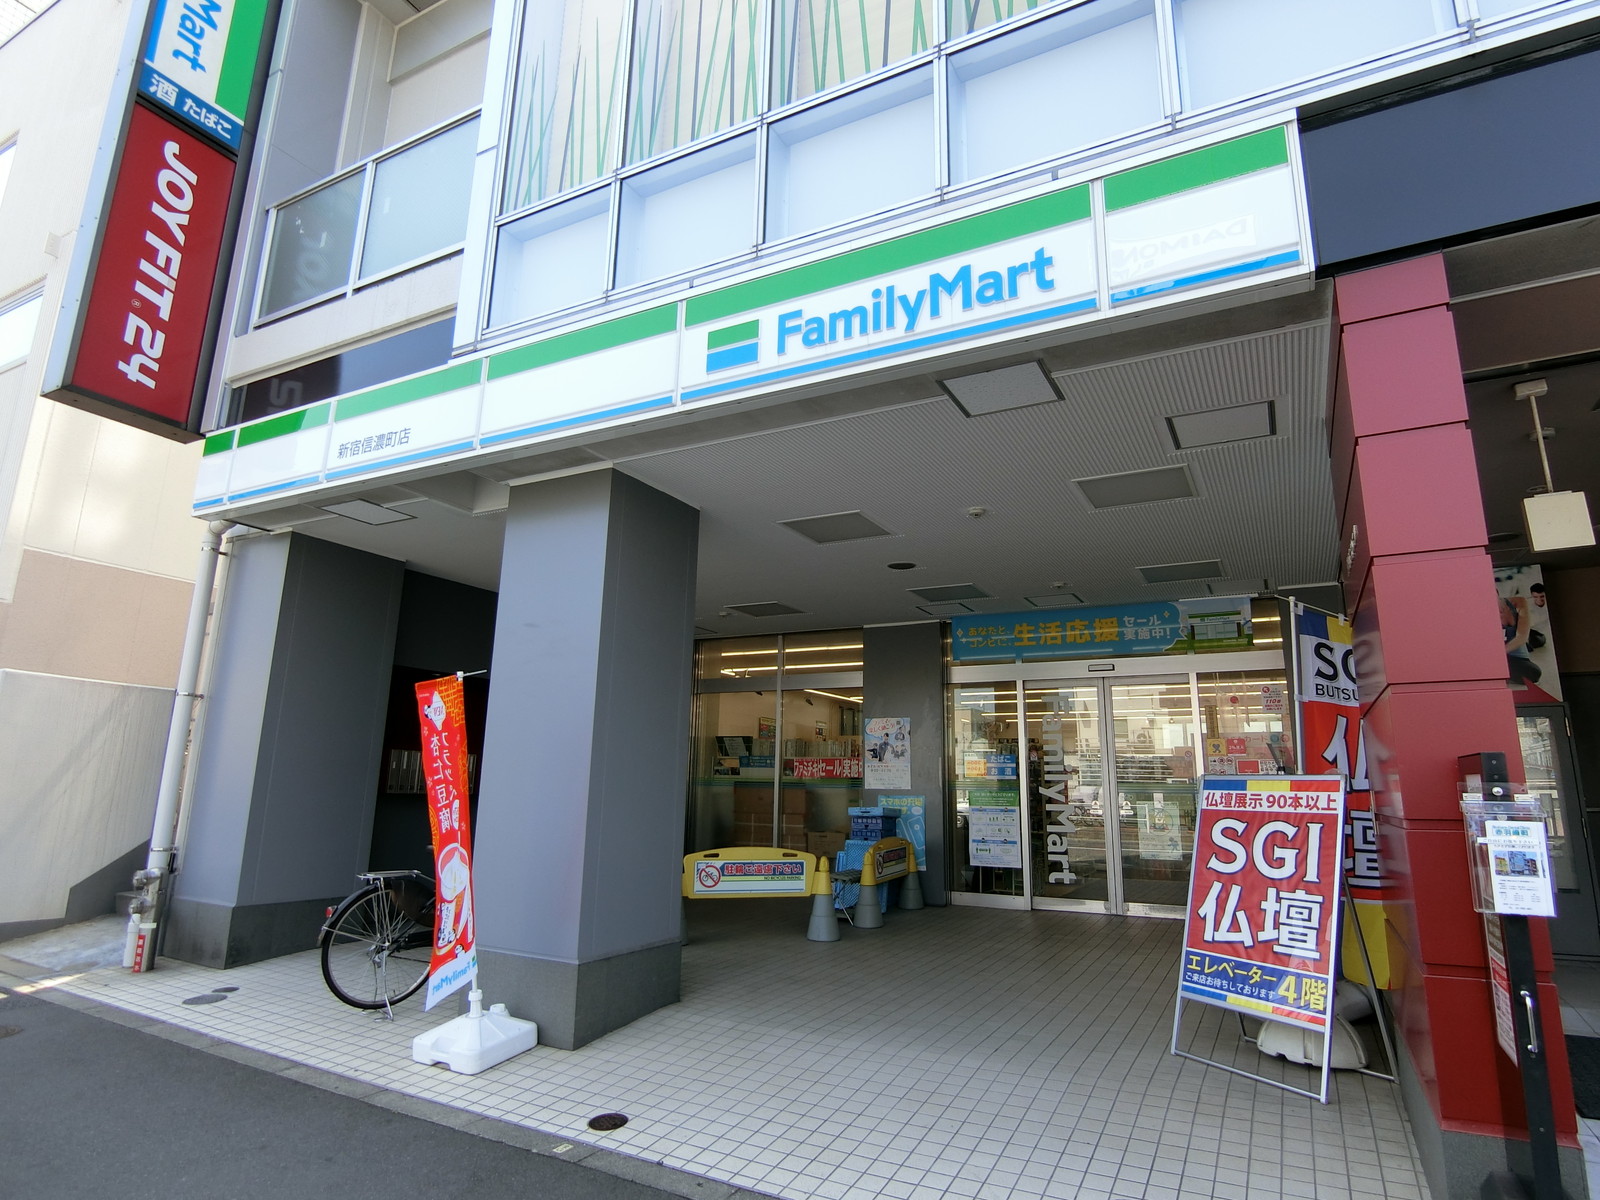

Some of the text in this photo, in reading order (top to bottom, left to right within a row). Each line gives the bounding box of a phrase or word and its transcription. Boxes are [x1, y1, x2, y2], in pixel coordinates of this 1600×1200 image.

[149, 73, 232, 139] 酒 たばこ
[777, 247, 1055, 356] FamilyMart
[337, 428, 411, 459] 新宿信濃町店
[1014, 617, 1120, 647] 生活応援
[1123, 614, 1162, 627] セール
[1039, 695, 1077, 886] FamilyMart
[1204, 792, 1337, 811] 仏壇展示 90本以上
[1206, 818, 1322, 883] SGI
[724, 863, 802, 875] 駐輪ご遠慮下さい
[1197, 880, 1324, 960] 仏壇
[1187, 955, 1277, 984] エレベーター
[1185, 971, 1276, 1000] ご来店お待ちしております
[1277, 977, 1327, 1011] 4階
